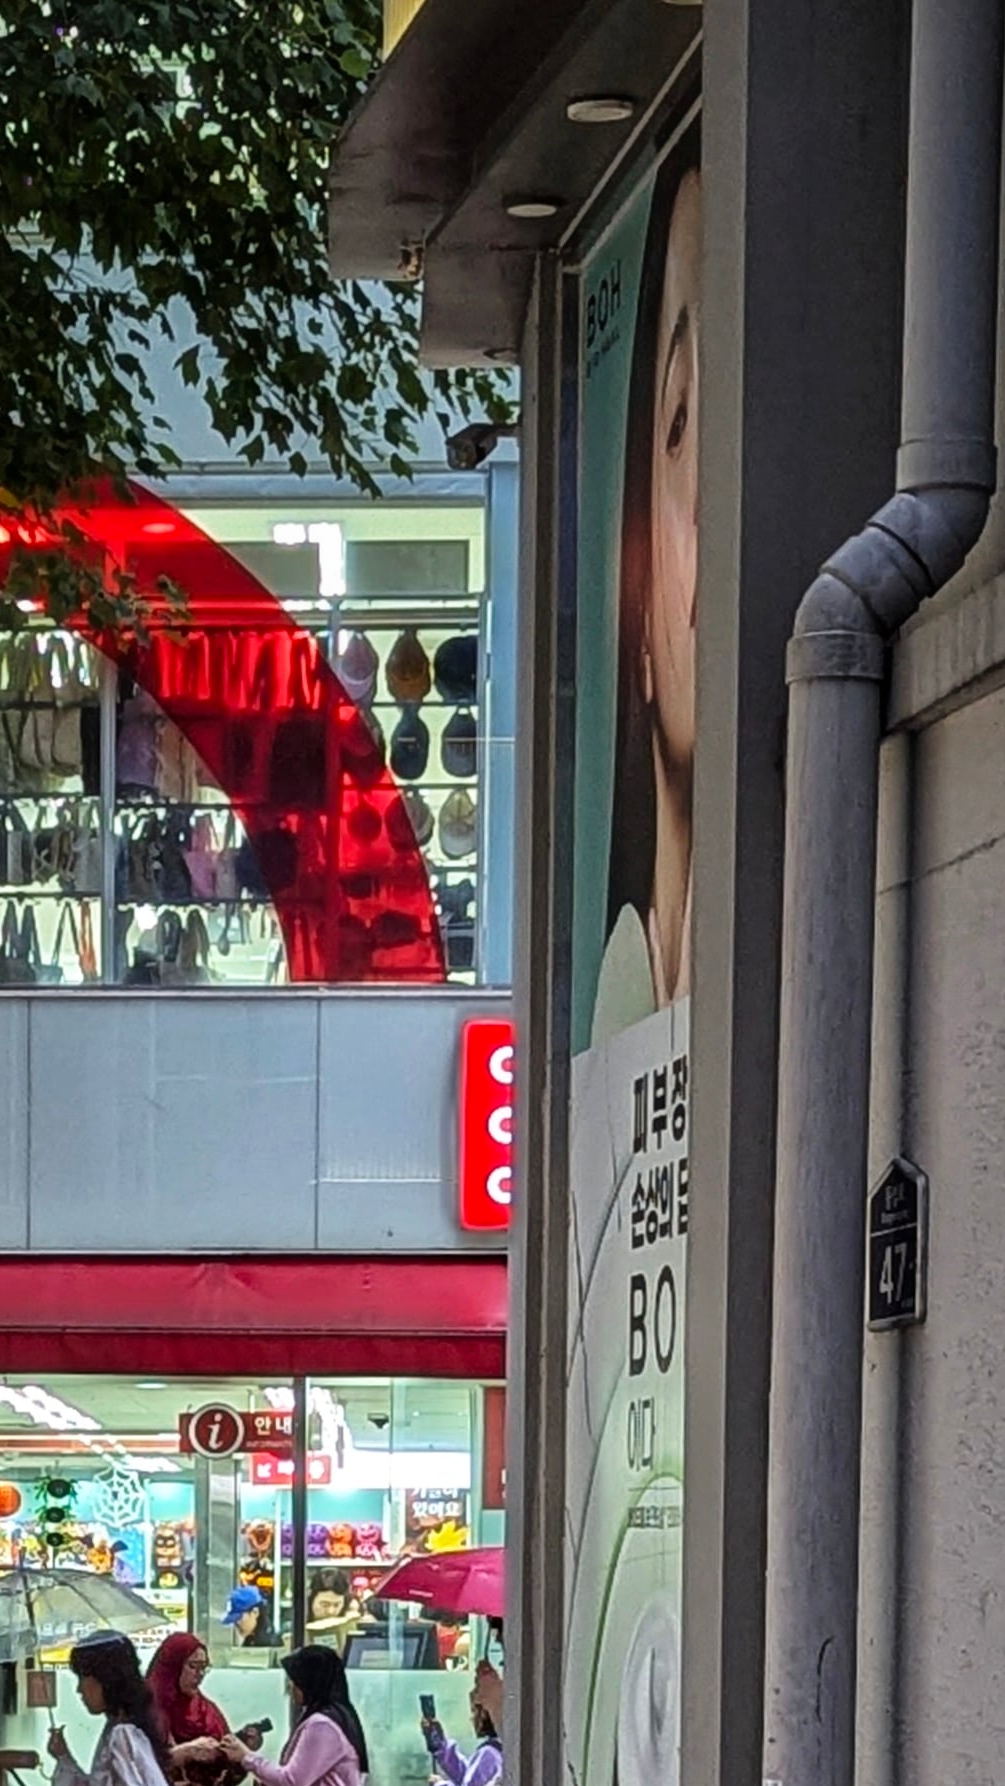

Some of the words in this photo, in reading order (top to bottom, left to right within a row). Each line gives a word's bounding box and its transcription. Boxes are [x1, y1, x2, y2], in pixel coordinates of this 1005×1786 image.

[586, 258, 622, 348] BOH
[631, 1161, 673, 1249] 손상의
[879, 1242, 907, 1304] 47
[629, 1264, 676, 1377] BO
[254, 1416, 292, 1435] 안내
